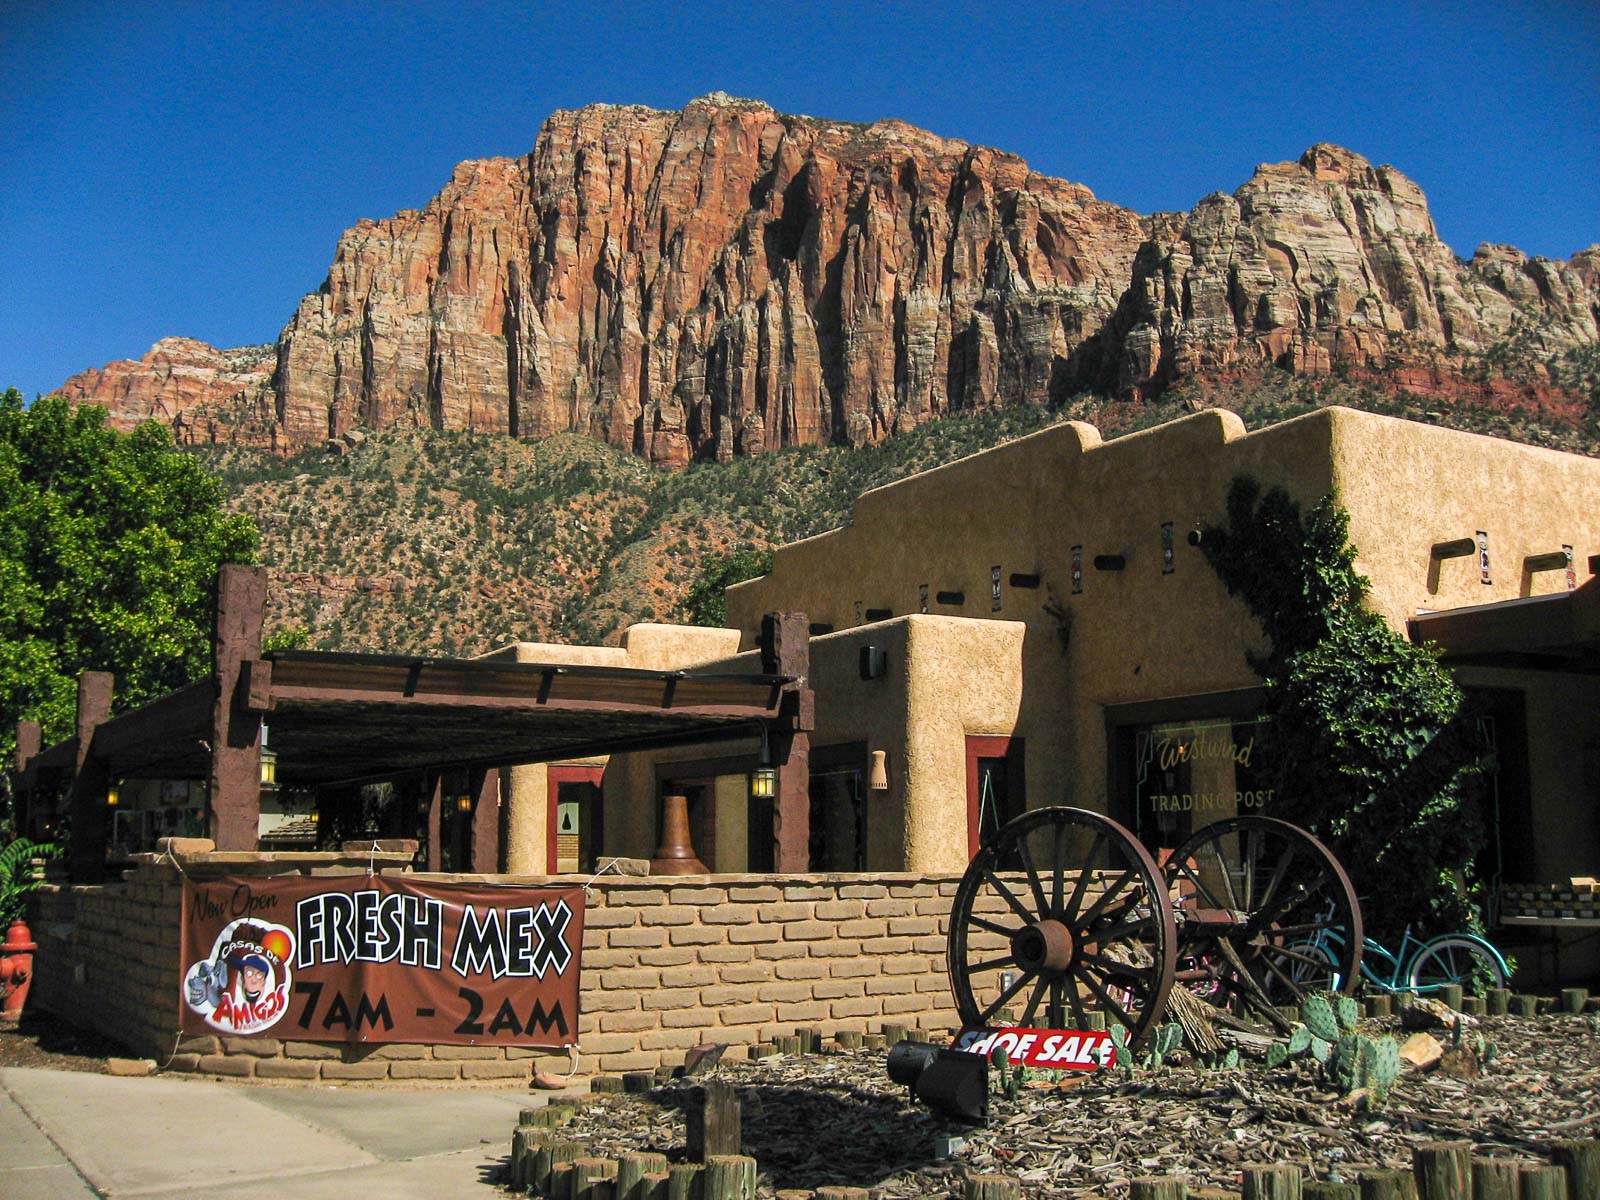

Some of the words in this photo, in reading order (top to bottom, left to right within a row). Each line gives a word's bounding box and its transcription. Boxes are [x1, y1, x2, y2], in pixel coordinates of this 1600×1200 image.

[1156, 732, 1254, 771] Westwind
[1150, 792, 1227, 812] TRADING
[1234, 789, 1275, 809] POST
[190, 888, 228, 922] Now
[232, 884, 279, 921] Open
[221, 940, 264, 960] CASAS
[296, 890, 445, 970] FRESH
[452, 897, 574, 981] MEX
[212, 983, 286, 1031] AMIGOS
[295, 981, 395, 1033] 7AM
[453, 986, 570, 1037] 2AM
[955, 1030, 1038, 1059] SHOE
[1035, 1032, 1115, 1065] SALE
